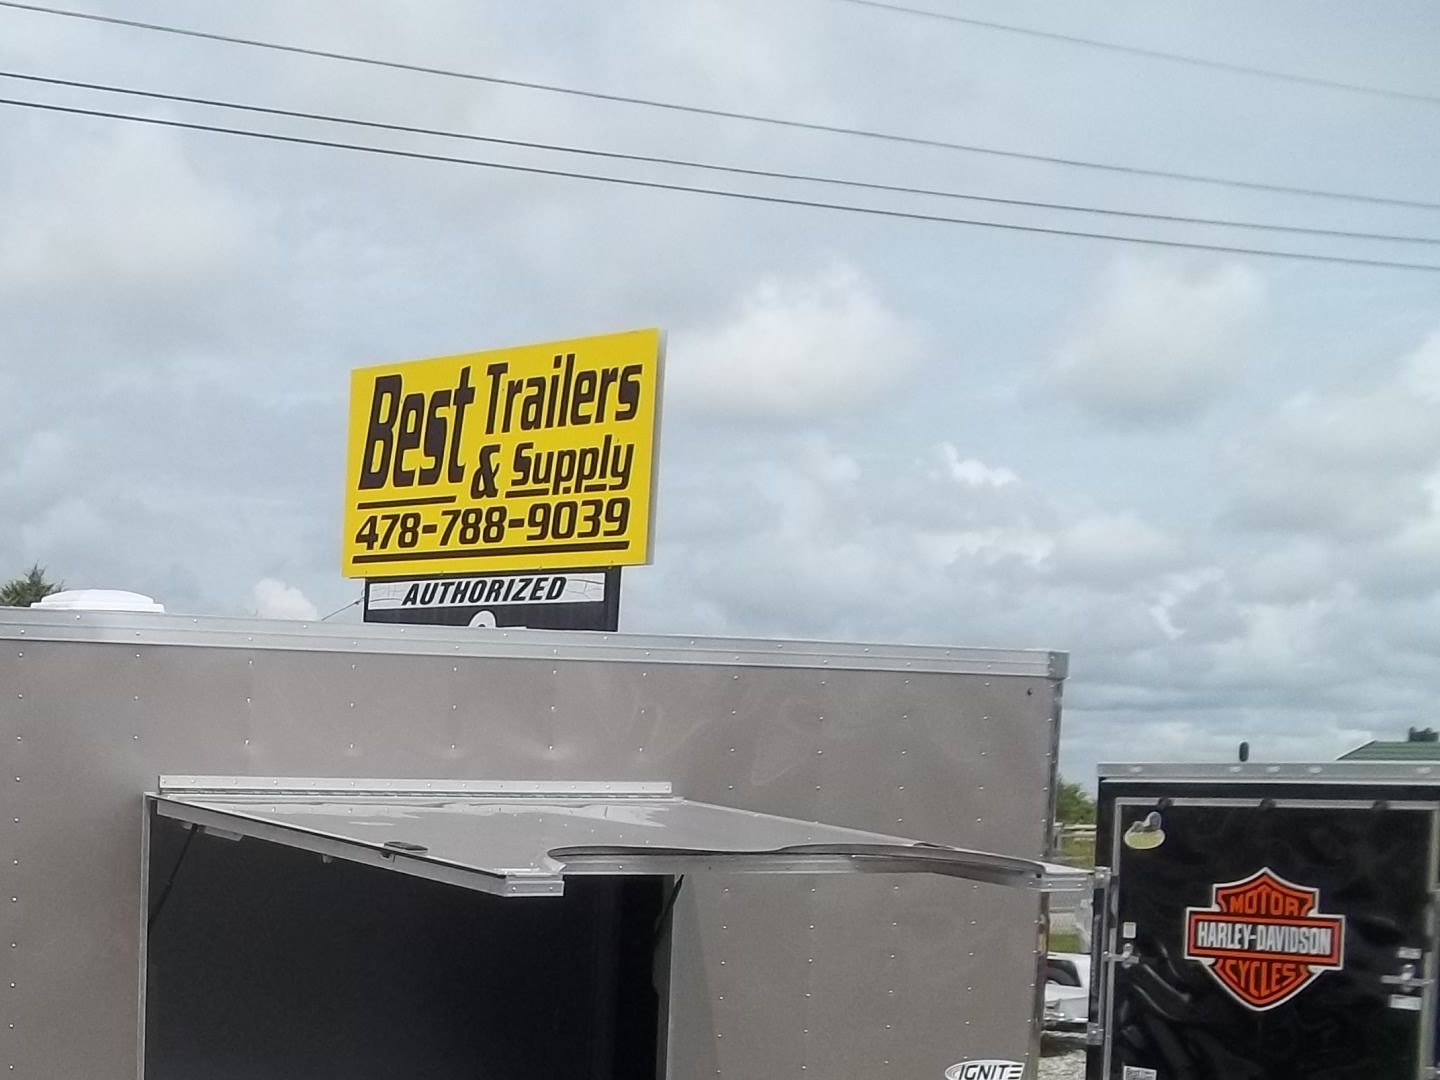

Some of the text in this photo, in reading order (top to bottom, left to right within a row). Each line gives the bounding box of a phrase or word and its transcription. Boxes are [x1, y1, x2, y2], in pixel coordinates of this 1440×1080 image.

[358, 354, 643, 490] Best Trailers
[471, 434, 635, 499] & Supply
[355, 497, 630, 550] 478-788-9039
[402, 576, 567, 606] AUTHORIZED
[1229, 886, 1299, 917] MOTOR
[1196, 921, 1333, 956] HARLEY-DAVIDSON
[1225, 958, 1297, 998] CYCLES
[959, 1064, 1023, 1080] IGNITE
